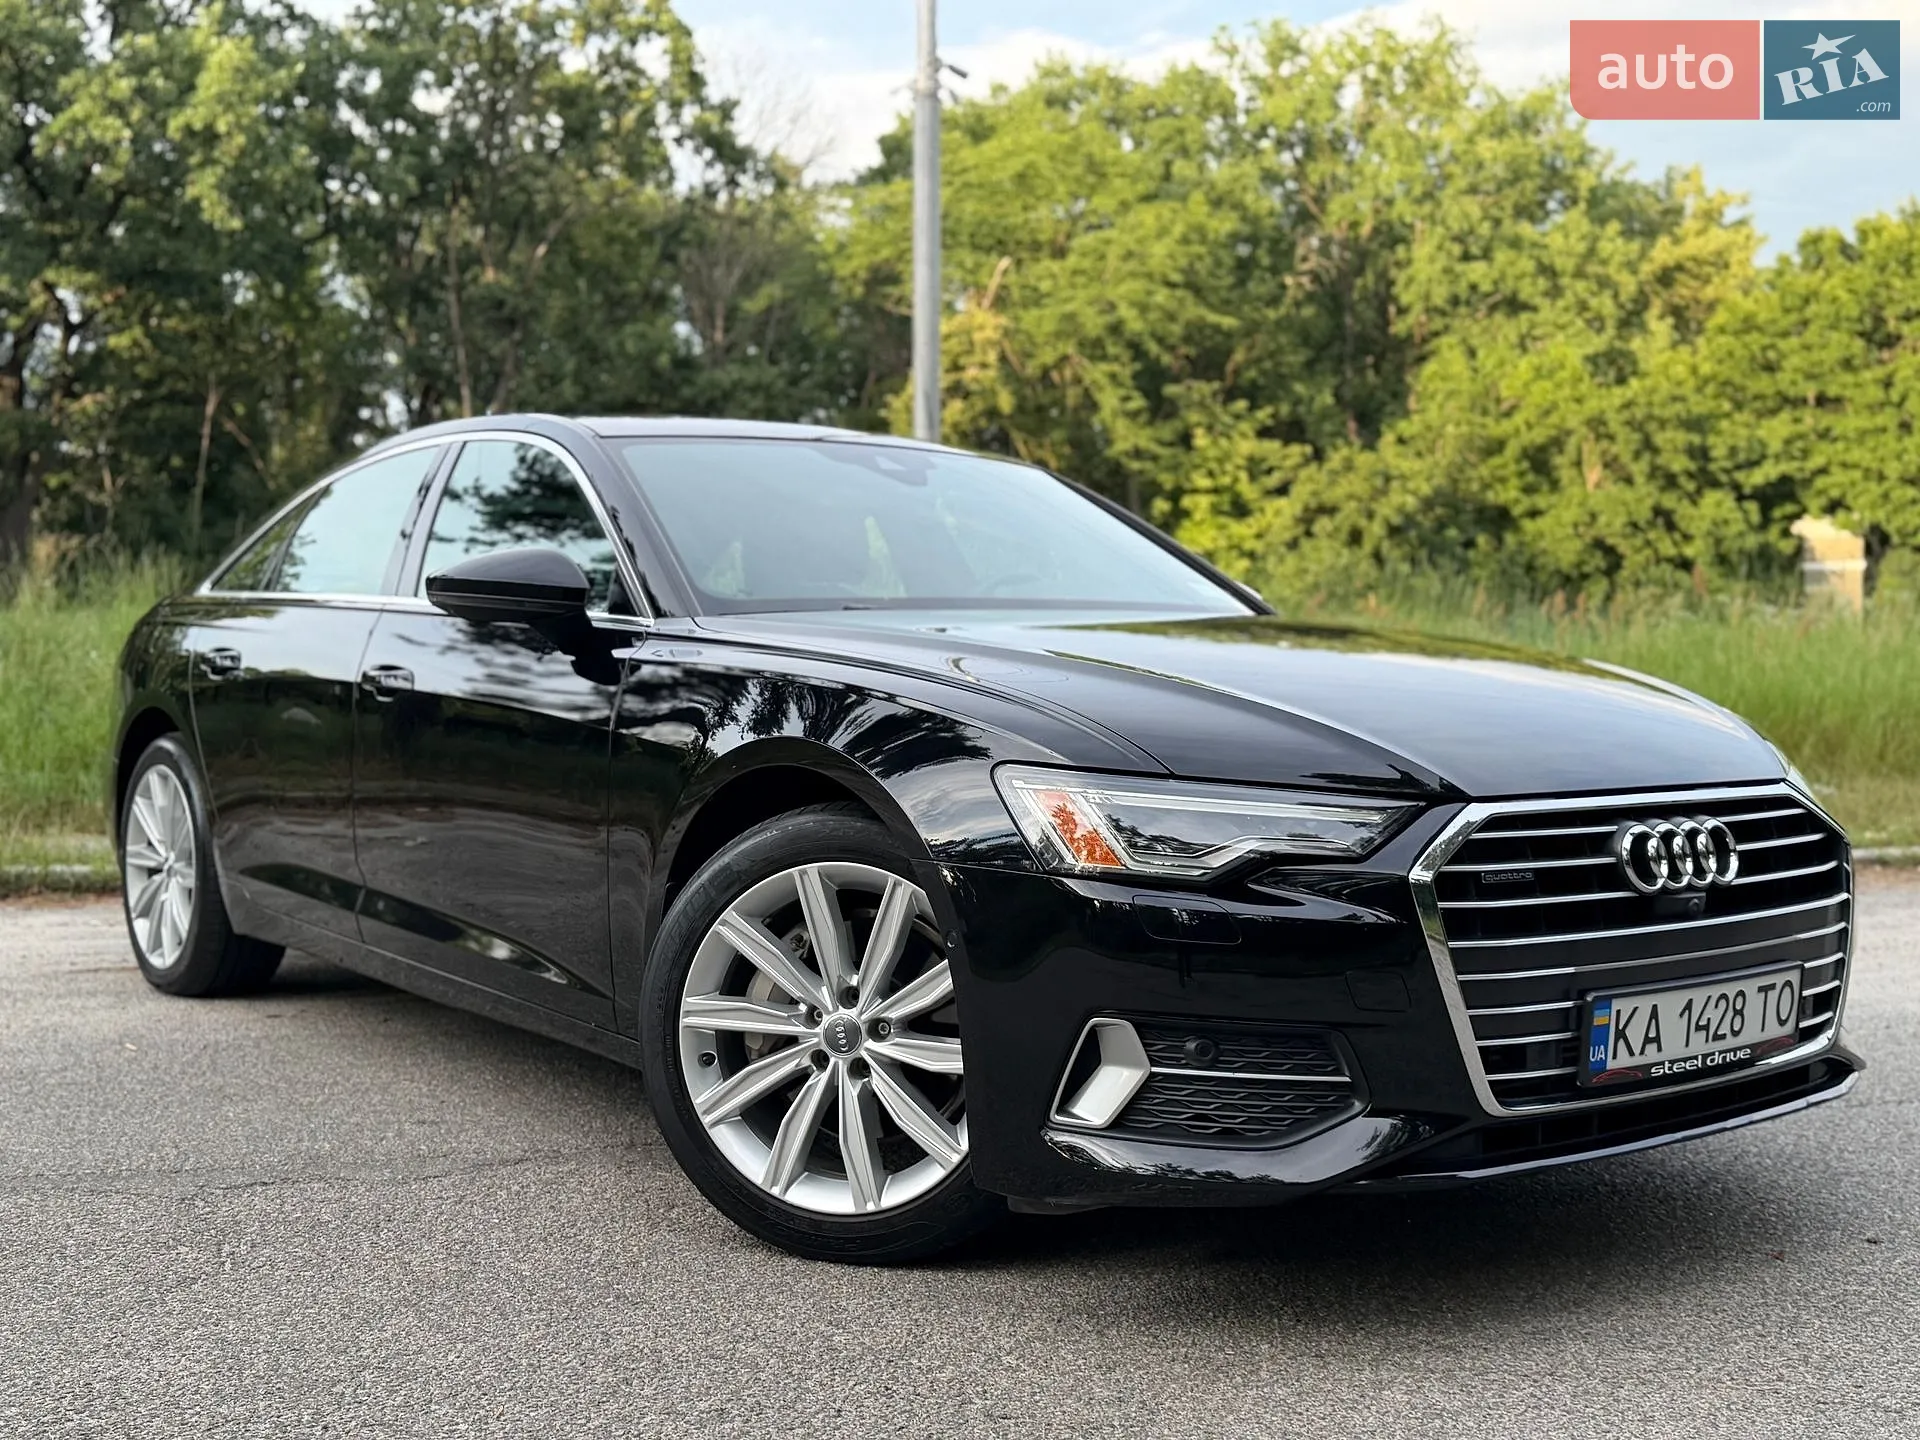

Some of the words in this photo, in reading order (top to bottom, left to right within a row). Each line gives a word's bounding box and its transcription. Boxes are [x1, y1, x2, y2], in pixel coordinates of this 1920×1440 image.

[1485, 871, 1533, 882] quattro
[1612, 1003, 1663, 1060] KA
[1679, 989, 1747, 1048] 1428
[1757, 979, 1795, 1033] TO
[1589, 1045, 1606, 1062] UA
[1650, 1054, 1703, 1077] steel
[1706, 1048, 1752, 1067] drive
